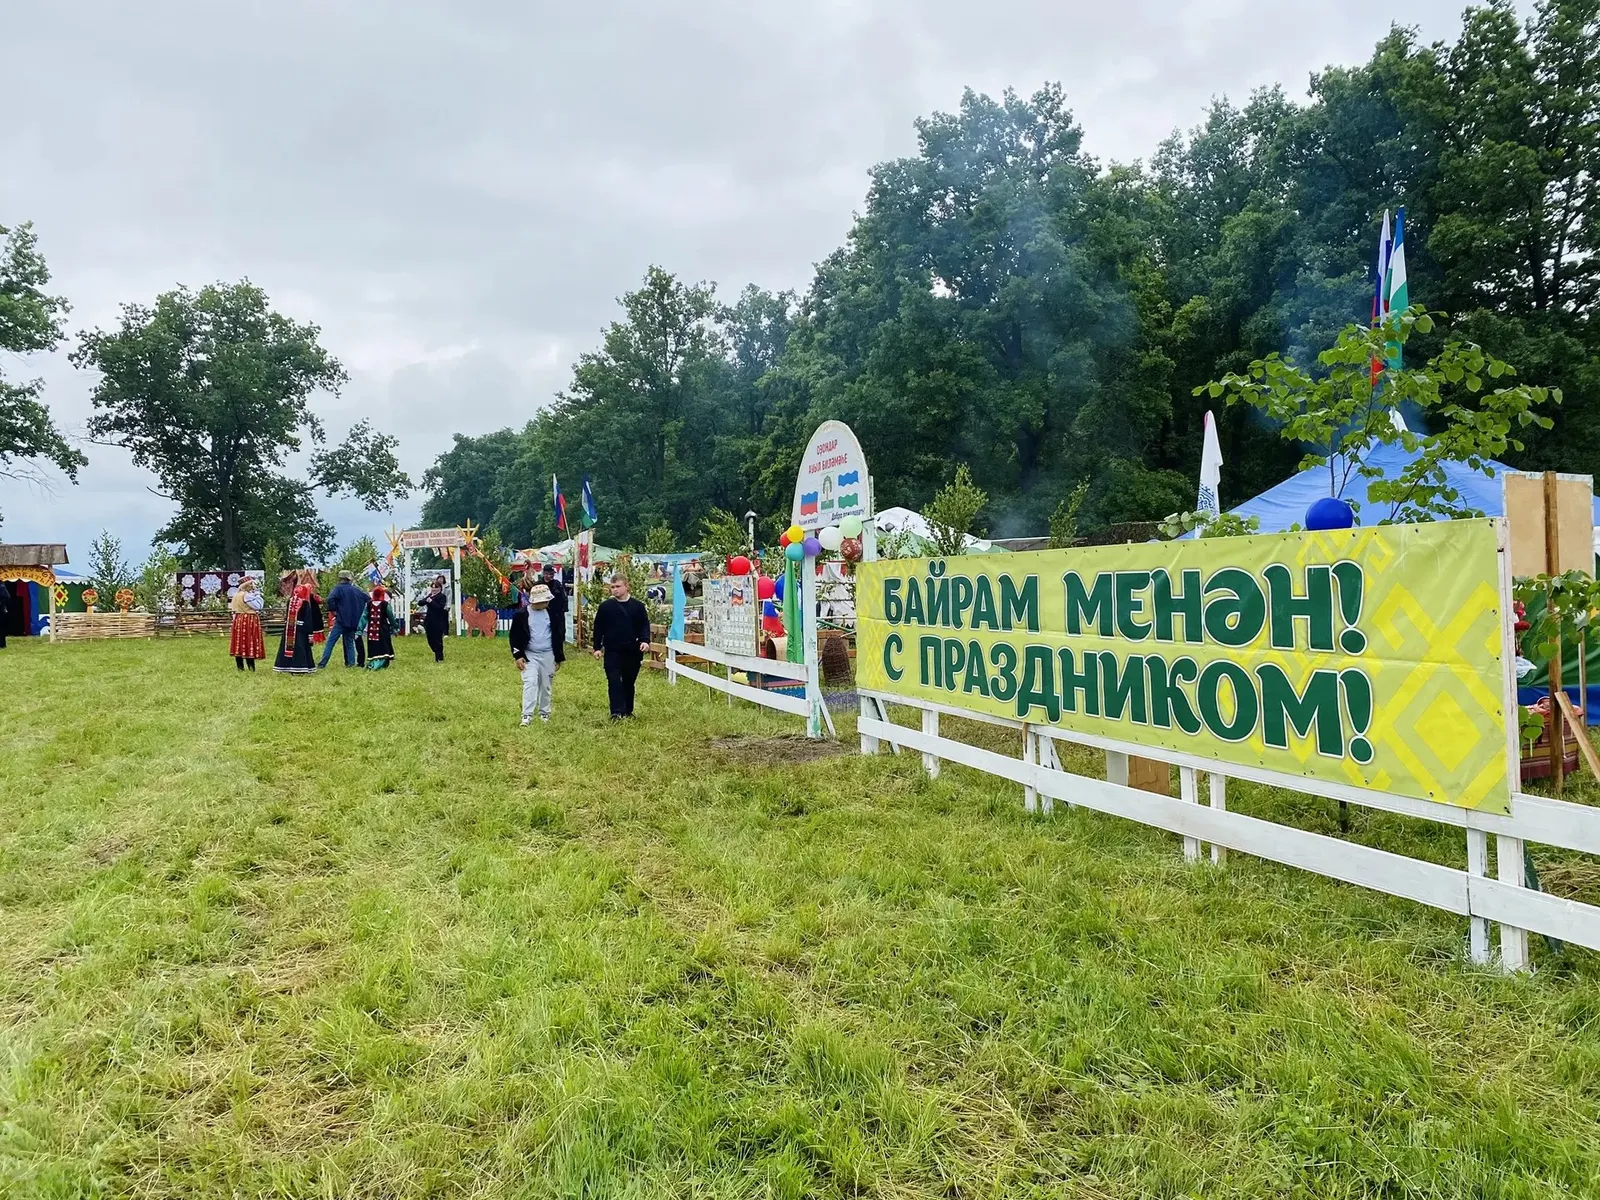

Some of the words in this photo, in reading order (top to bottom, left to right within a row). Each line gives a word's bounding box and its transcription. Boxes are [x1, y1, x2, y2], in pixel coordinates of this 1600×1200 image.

[884, 560, 1040, 631] БАЙРАМ
[1064, 562, 1366, 655] МЕНӘН!
[884, 634, 903, 681] С
[919, 637, 1374, 763] ПРАЗДНИКОМ!
